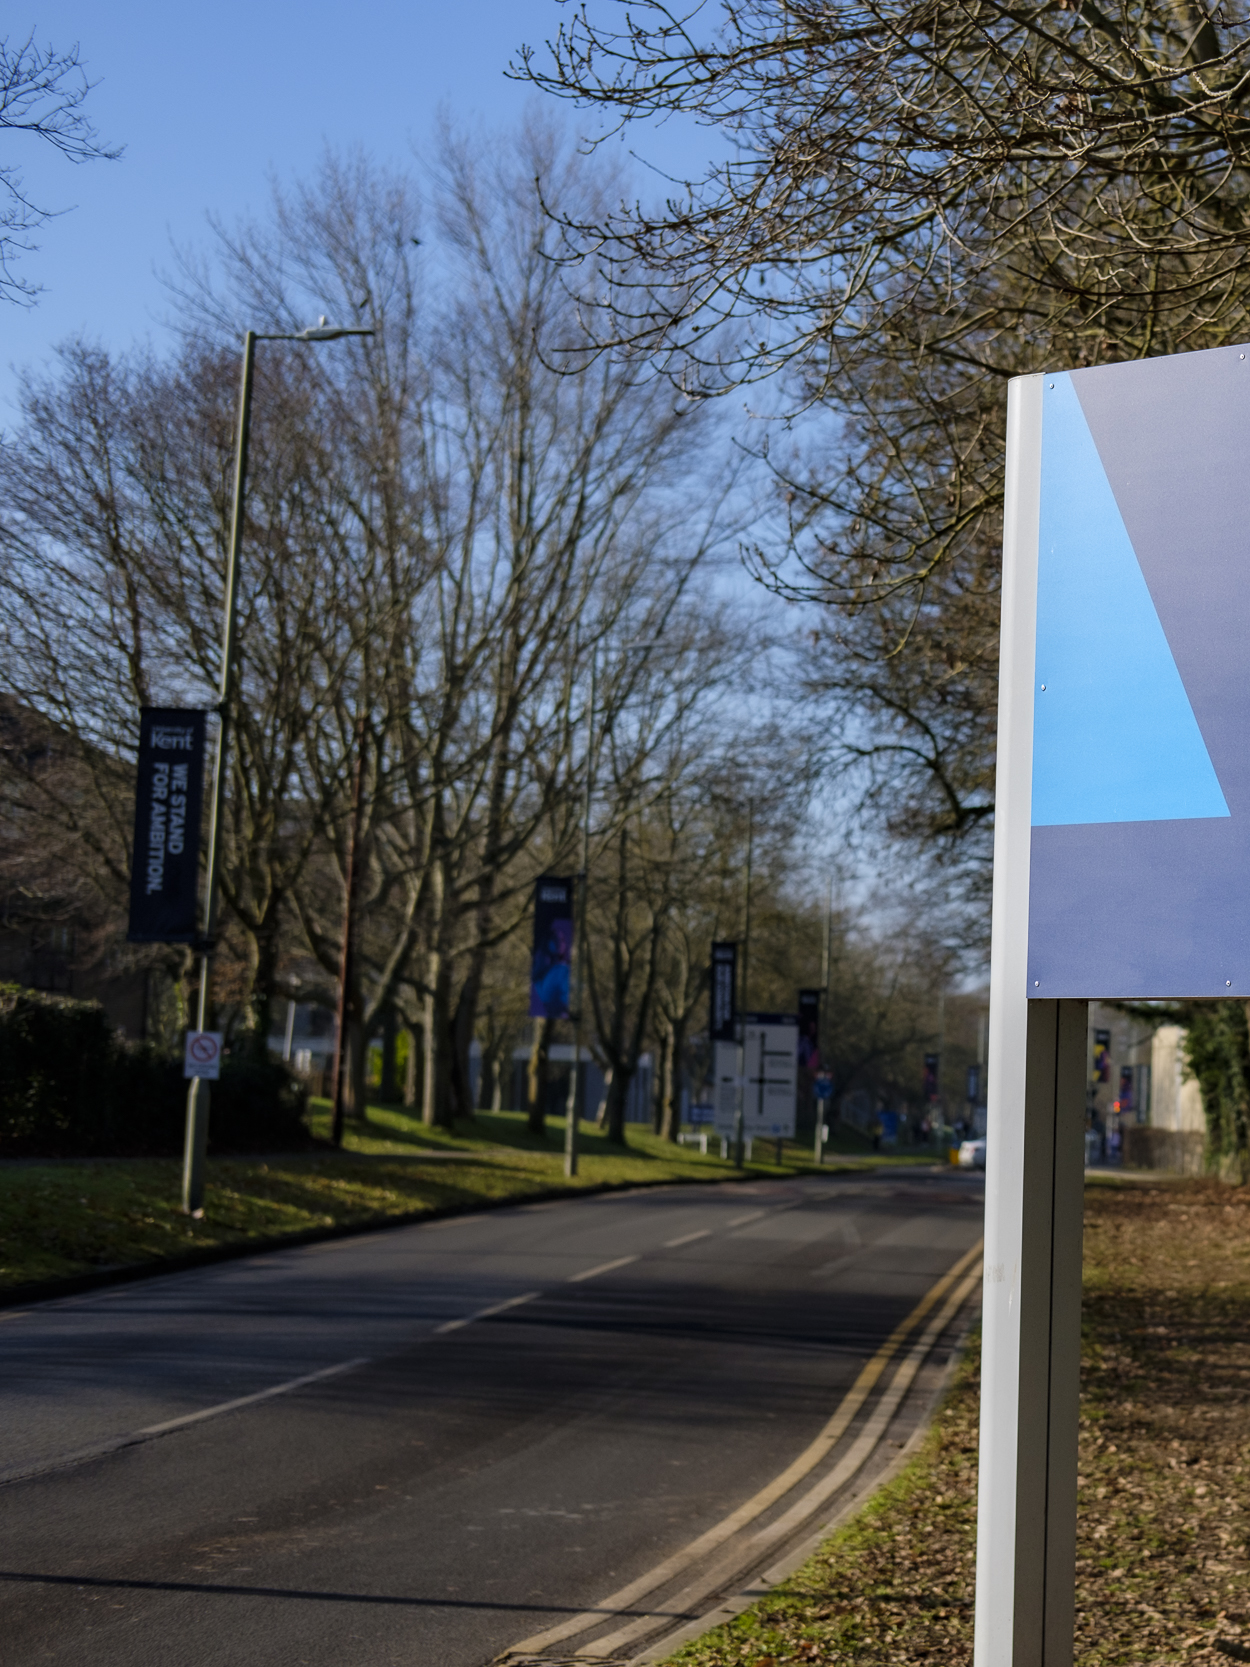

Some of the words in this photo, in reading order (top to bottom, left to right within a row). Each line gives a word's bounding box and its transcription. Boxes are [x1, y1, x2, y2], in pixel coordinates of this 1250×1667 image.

[151, 730, 194, 751] Kent
[152, 762, 169, 799] FOR
[170, 763, 188, 791] WE
[168, 794, 186, 854] STAND
